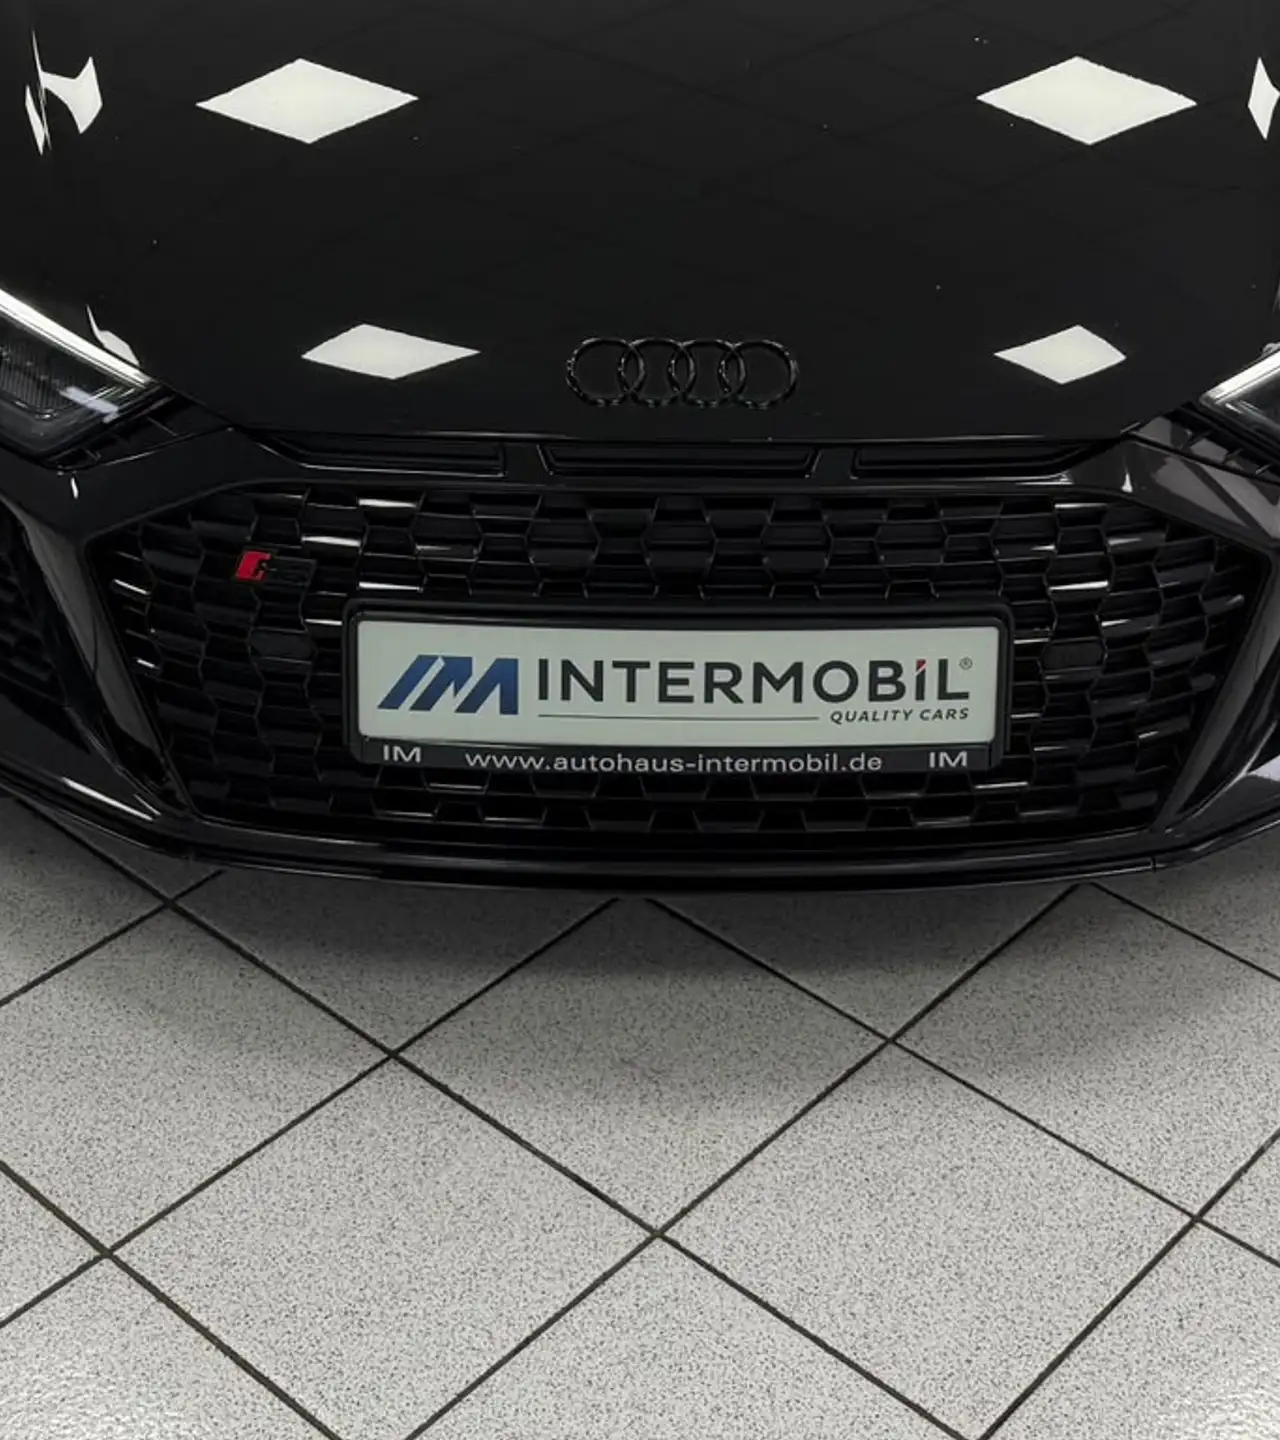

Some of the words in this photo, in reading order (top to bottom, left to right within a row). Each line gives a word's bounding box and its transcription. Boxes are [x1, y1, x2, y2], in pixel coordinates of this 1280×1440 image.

[829, 709, 914, 725] QUALITY
[919, 707, 970, 721] CARS
[382, 744, 422, 763] IM
[464, 751, 883, 773] www.autohaus-intermobil.de
[928, 751, 968, 768] IM
